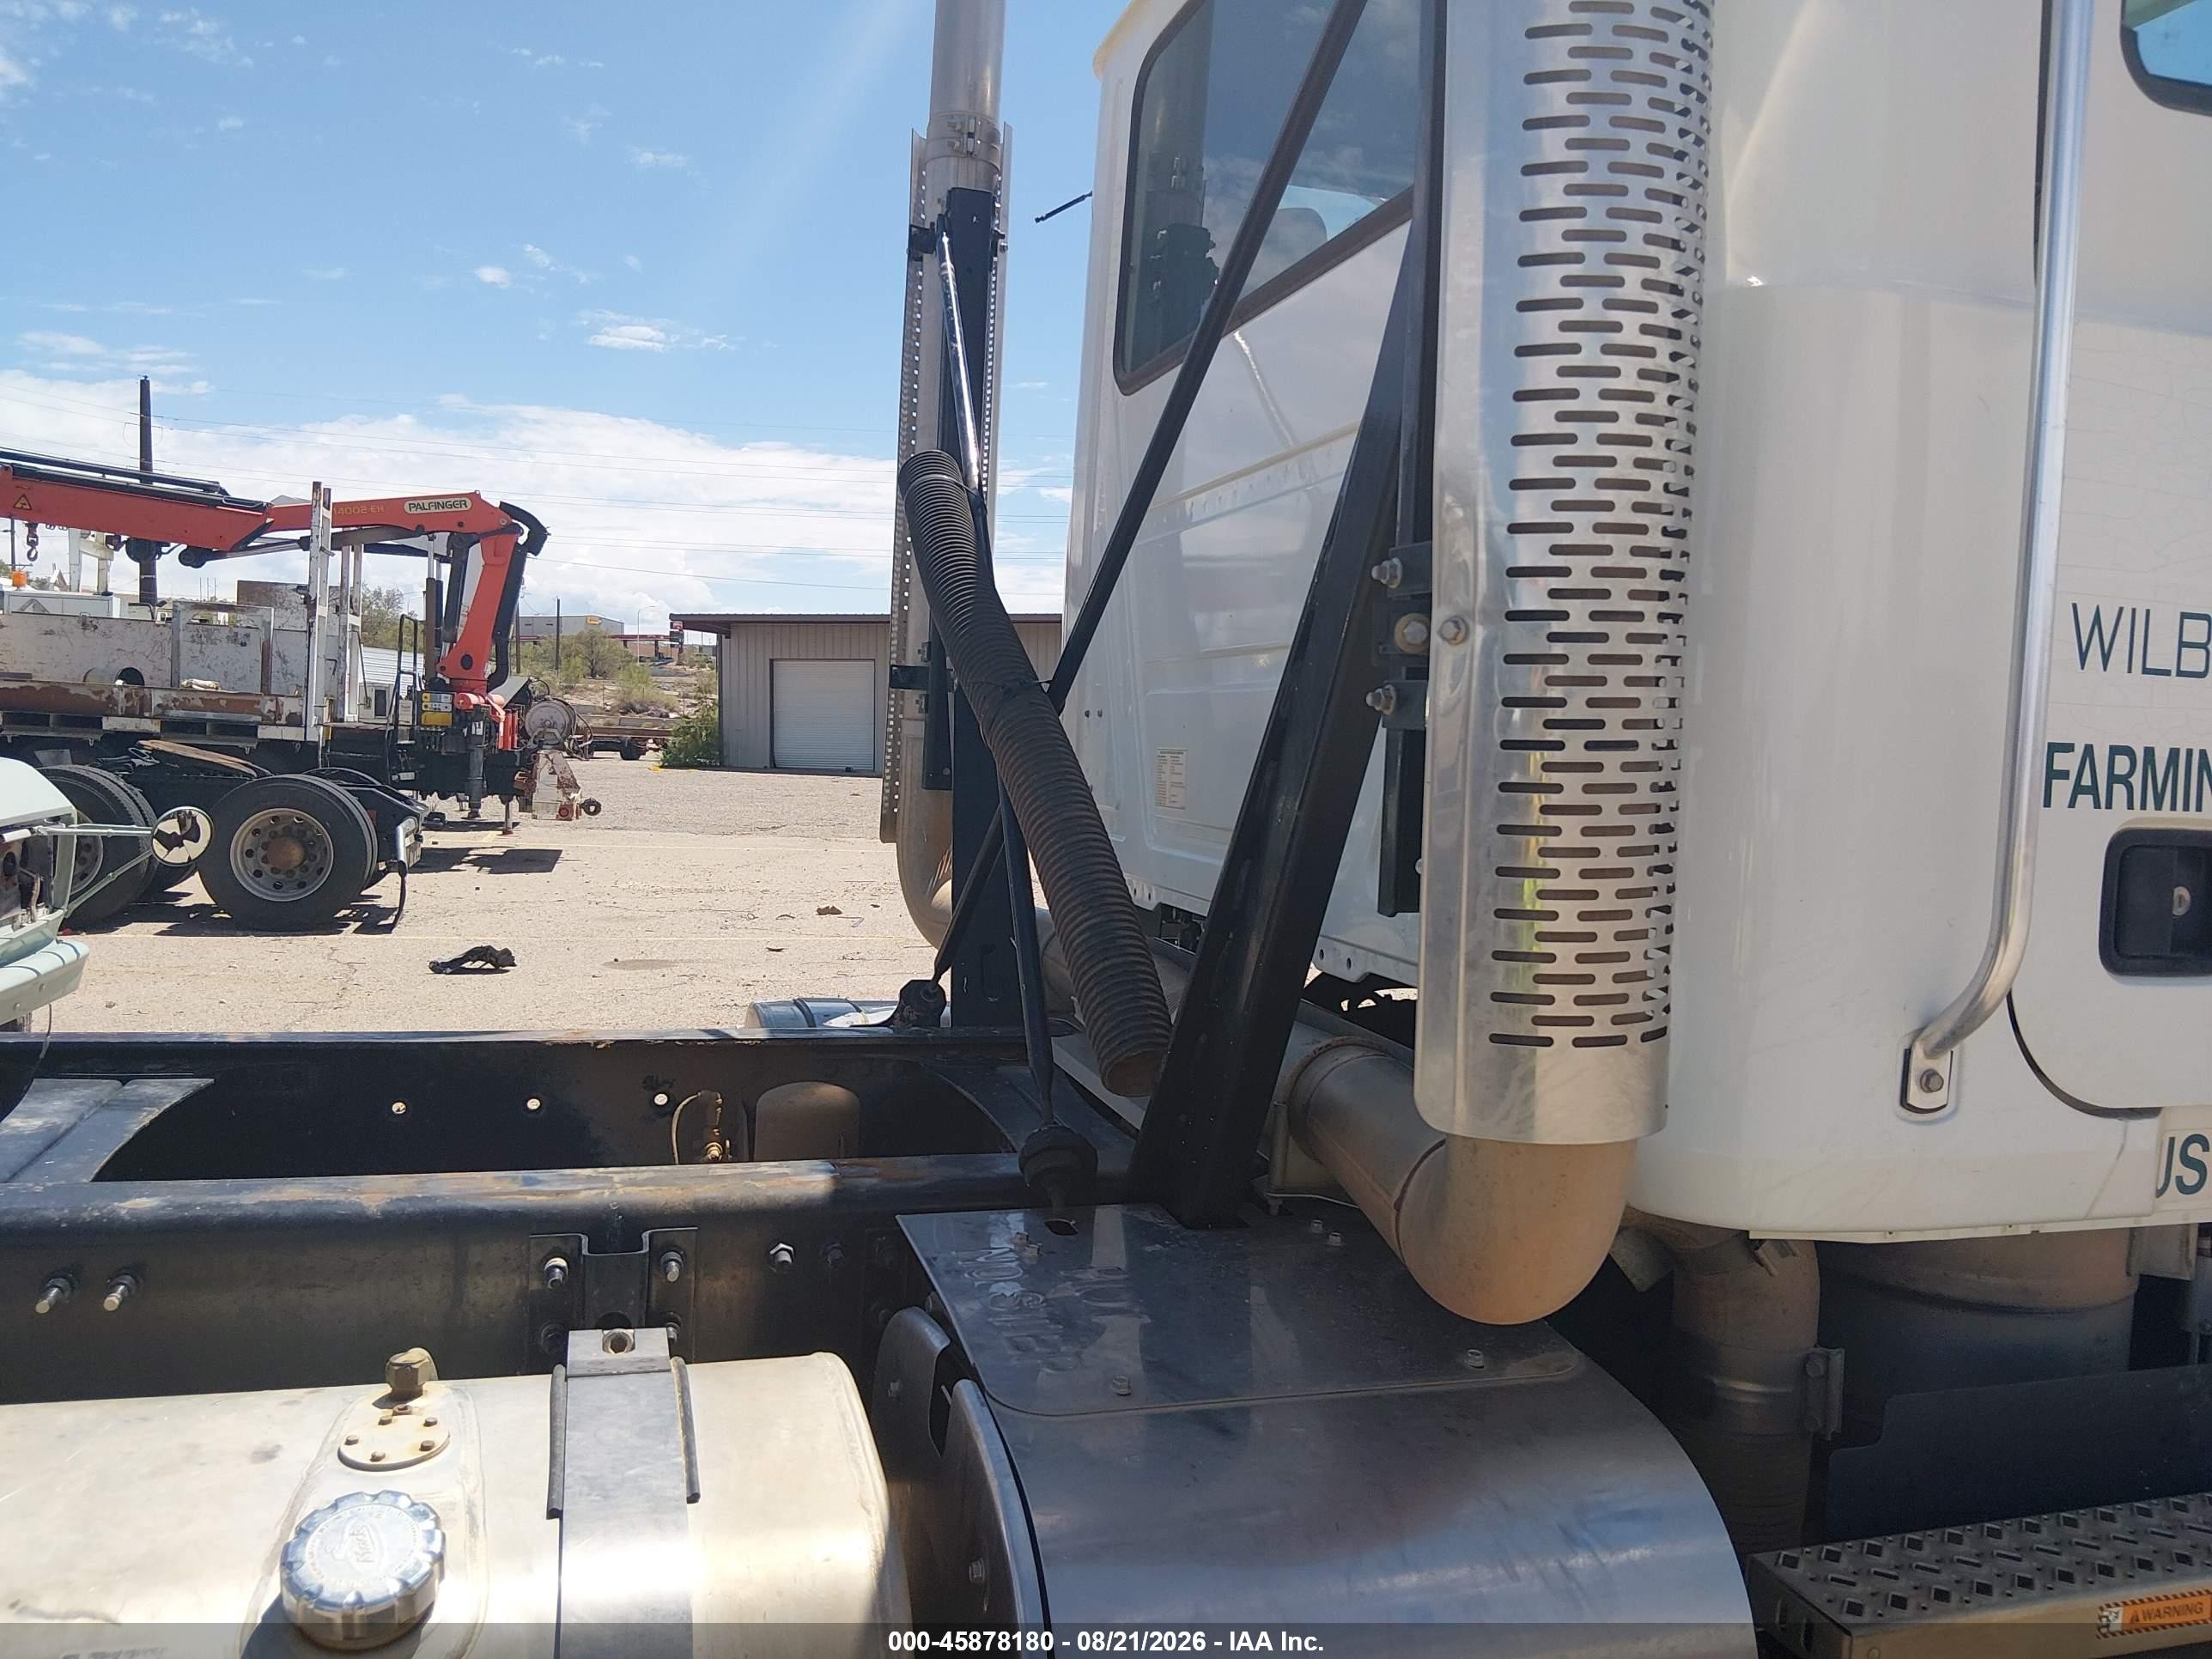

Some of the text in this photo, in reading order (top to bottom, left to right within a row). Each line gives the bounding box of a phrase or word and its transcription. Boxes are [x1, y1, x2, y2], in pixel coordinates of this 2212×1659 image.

[408, 500, 468, 512] PALFINGER
[2071, 602, 2212, 679] WILB
[2142, 1601, 2203, 1622] WARNING
